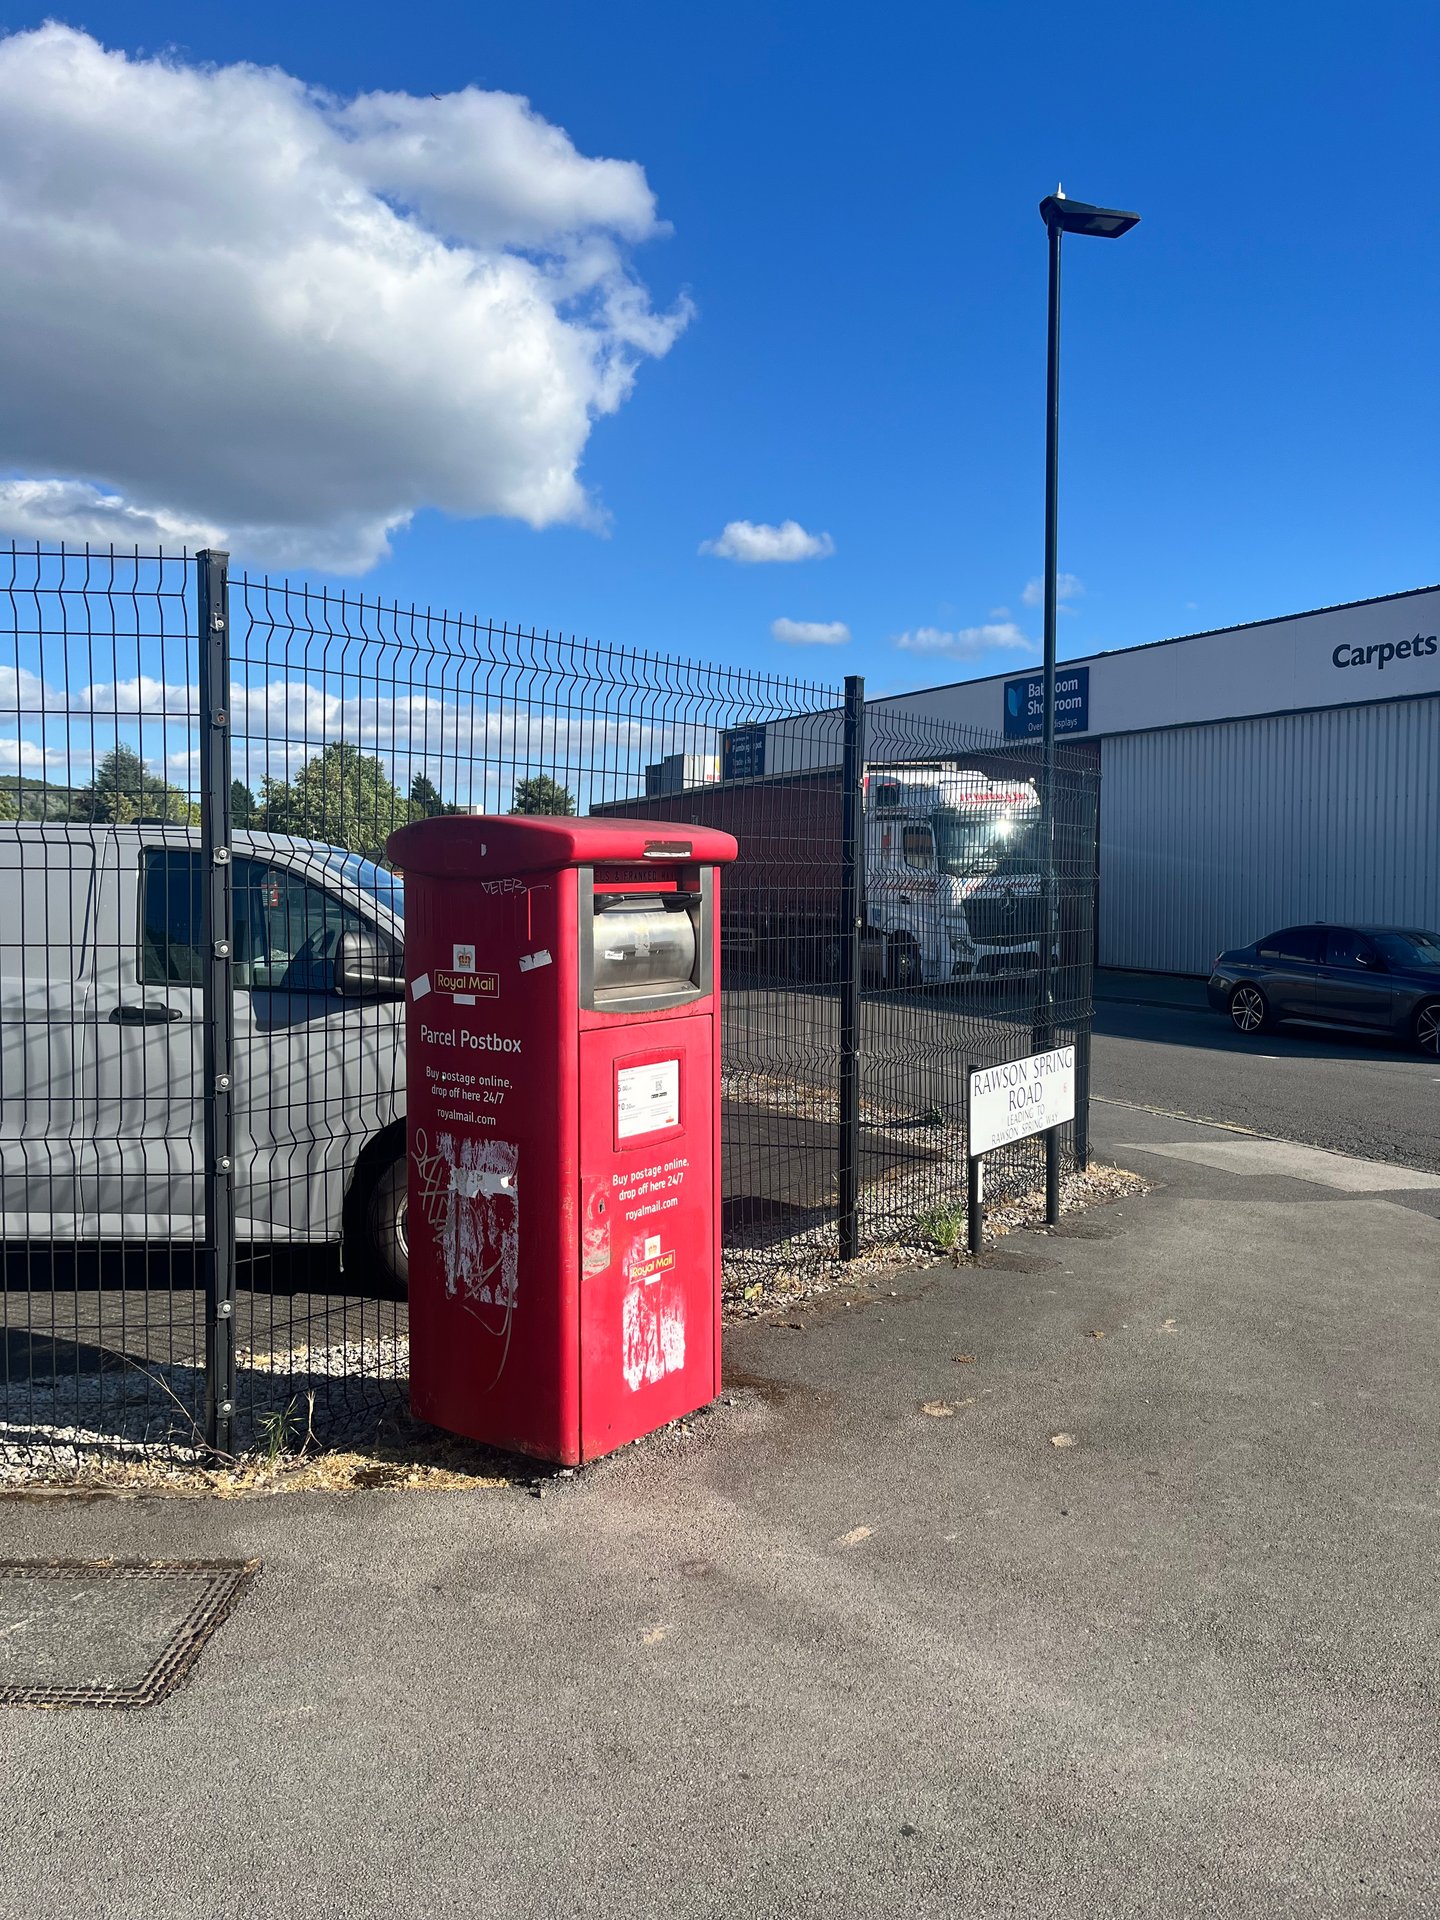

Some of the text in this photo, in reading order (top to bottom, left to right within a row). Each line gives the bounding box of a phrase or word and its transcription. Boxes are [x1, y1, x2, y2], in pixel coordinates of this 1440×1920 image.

[1332, 633, 1438, 670] Carpets
[1028, 679, 1078, 698] Batoom
[1027, 696, 1082, 716] Shoroom
[437, 974, 495, 991] Royal Mail
[421, 1024, 522, 1053] Parcel Postbox
[426, 1066, 513, 1089] Buy postage online,
[974, 1047, 1073, 1097] RAWSON SPRING
[431, 1084, 505, 1104] drop off here 24/7
[1009, 1081, 1043, 1111] ROAD
[437, 1108, 496, 1126] royalmail.com
[1007, 1104, 1045, 1126] LEADING TO
[991, 1113, 1059, 1146] RAWSON SPRING WAY
[612, 1158, 690, 1186] Buy postage online,
[619, 1172, 684, 1201] drop off here 24/7
[625, 1197, 678, 1221] royalmail.com
[631, 1254, 673, 1277] Royal Mail
